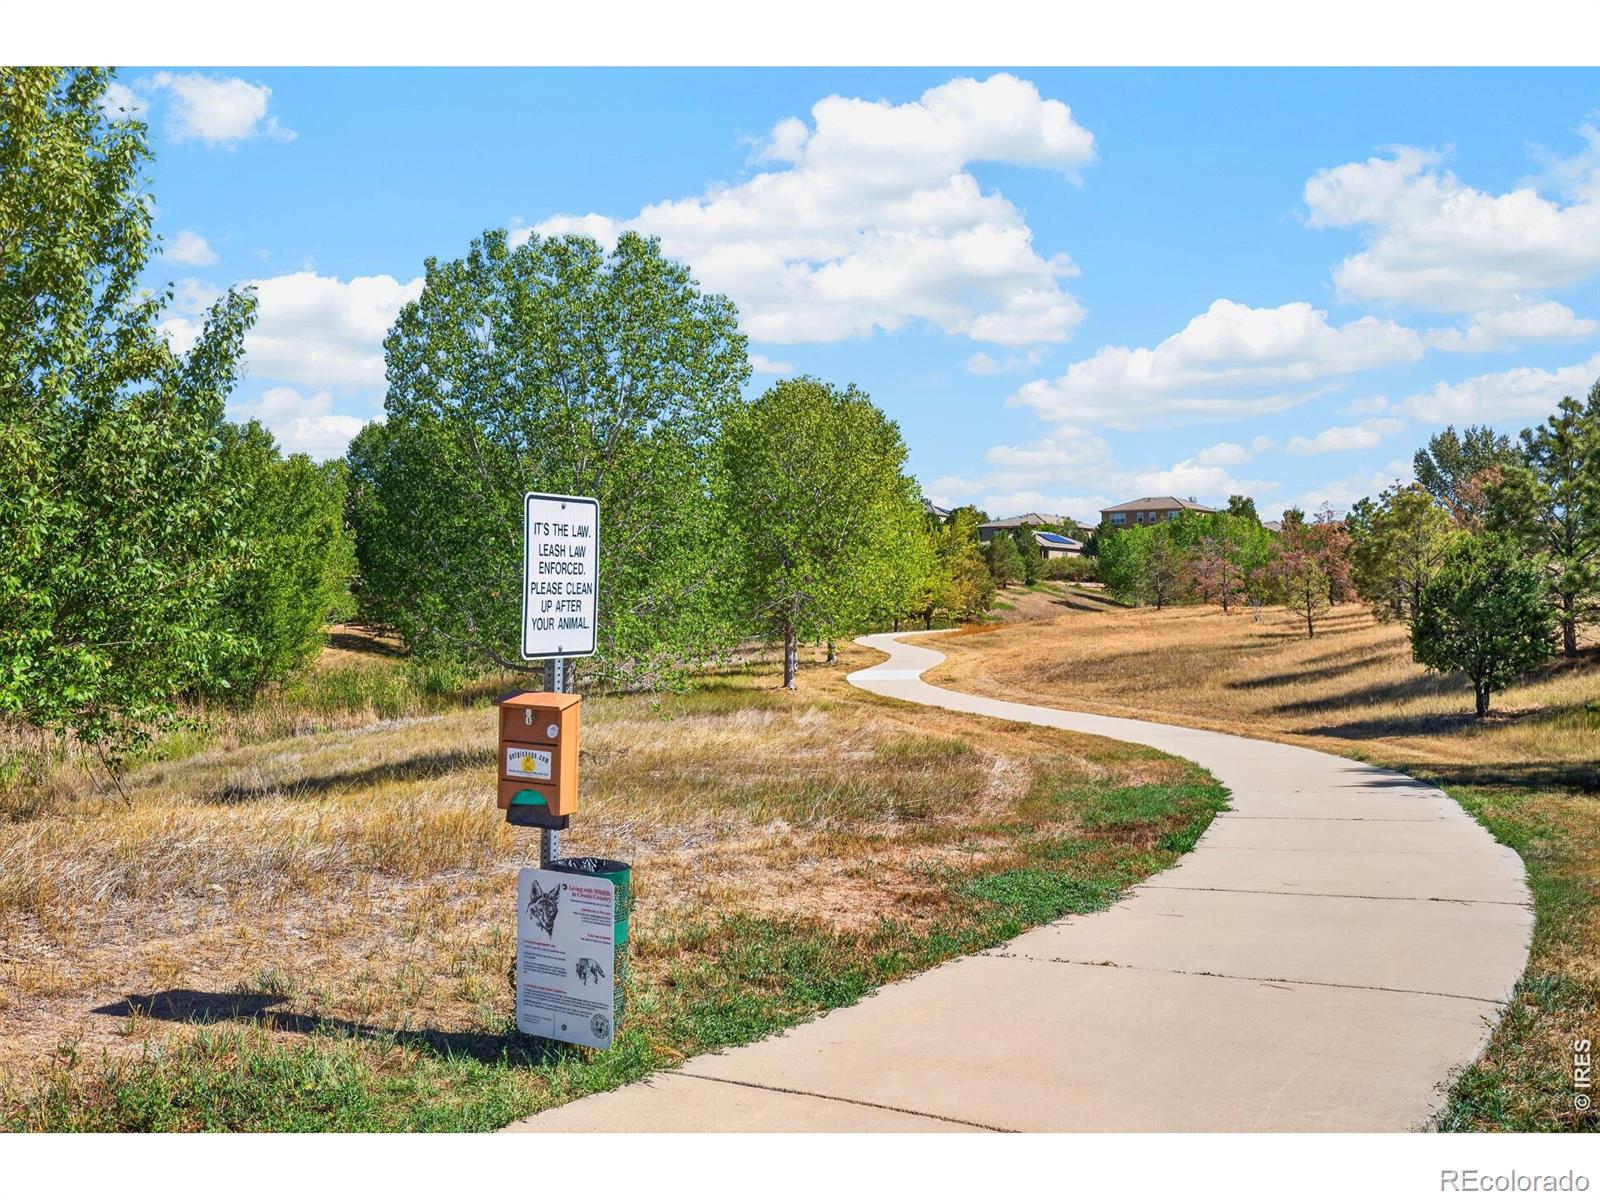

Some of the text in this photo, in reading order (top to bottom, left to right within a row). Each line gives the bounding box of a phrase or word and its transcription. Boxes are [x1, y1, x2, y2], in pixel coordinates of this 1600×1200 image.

[534, 522, 591, 538] IT'S THE LAW.
[538, 544, 586, 558] LEASH LAW
[538, 562, 586, 575] ENFORCED.
[530, 582, 592, 595] PLEASE CLEAN
[540, 600, 582, 612] UP AFTER
[532, 617, 590, 630] YOUR ANIMAL.
